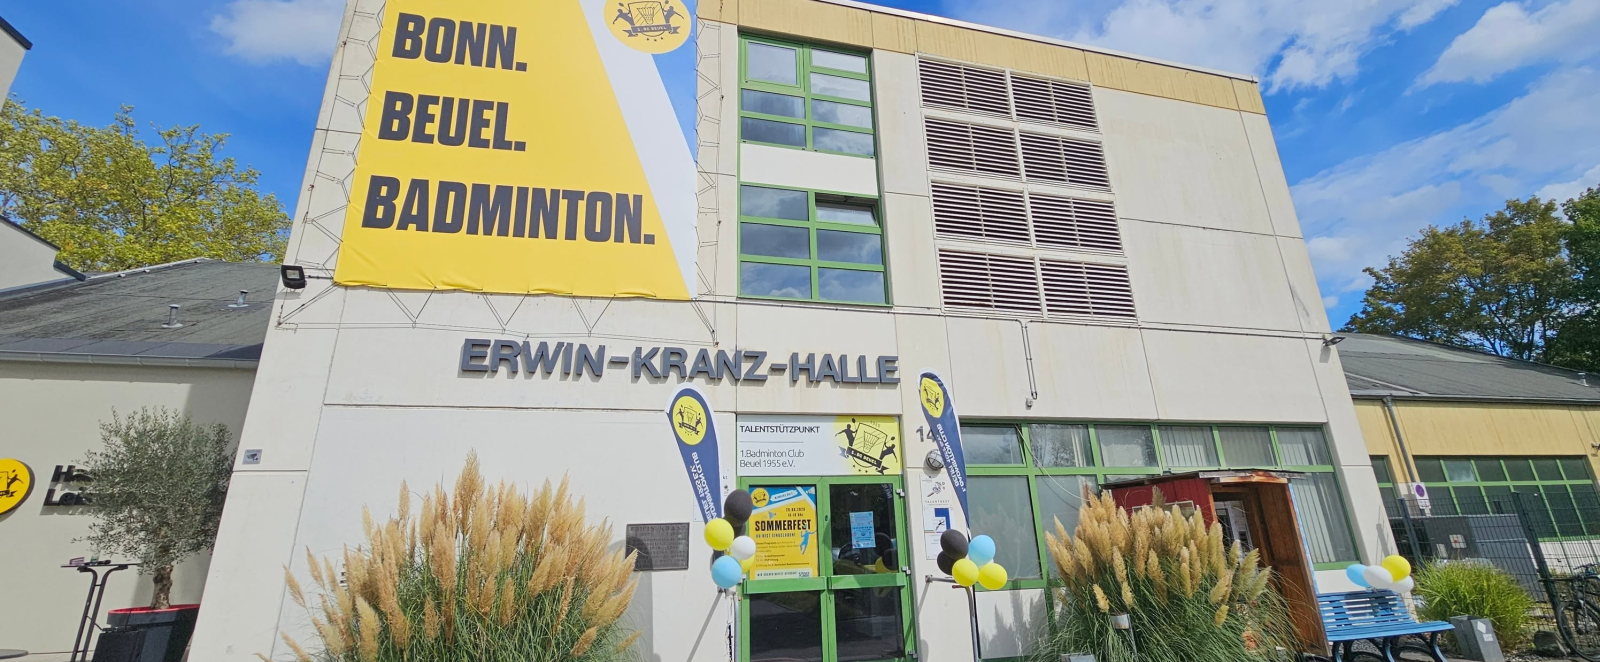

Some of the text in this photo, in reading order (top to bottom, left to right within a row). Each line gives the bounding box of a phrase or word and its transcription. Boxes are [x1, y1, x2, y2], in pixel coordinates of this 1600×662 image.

[392, 12, 528, 72] BONN.
[378, 90, 527, 152] BEUEL.
[361, 174, 656, 245] BADMINTON.
[460, 338, 901, 385] ERWIN-KRANZ-HALLE
[739, 424, 820, 434] TALENTSTÜTZPUNKT
[915, 425, 936, 443] 14
[787, 449, 805, 458] Club
[739, 459, 796, 468] Beuel 1955 e.V.
[755, 519, 811, 531] SOMMERFEST
